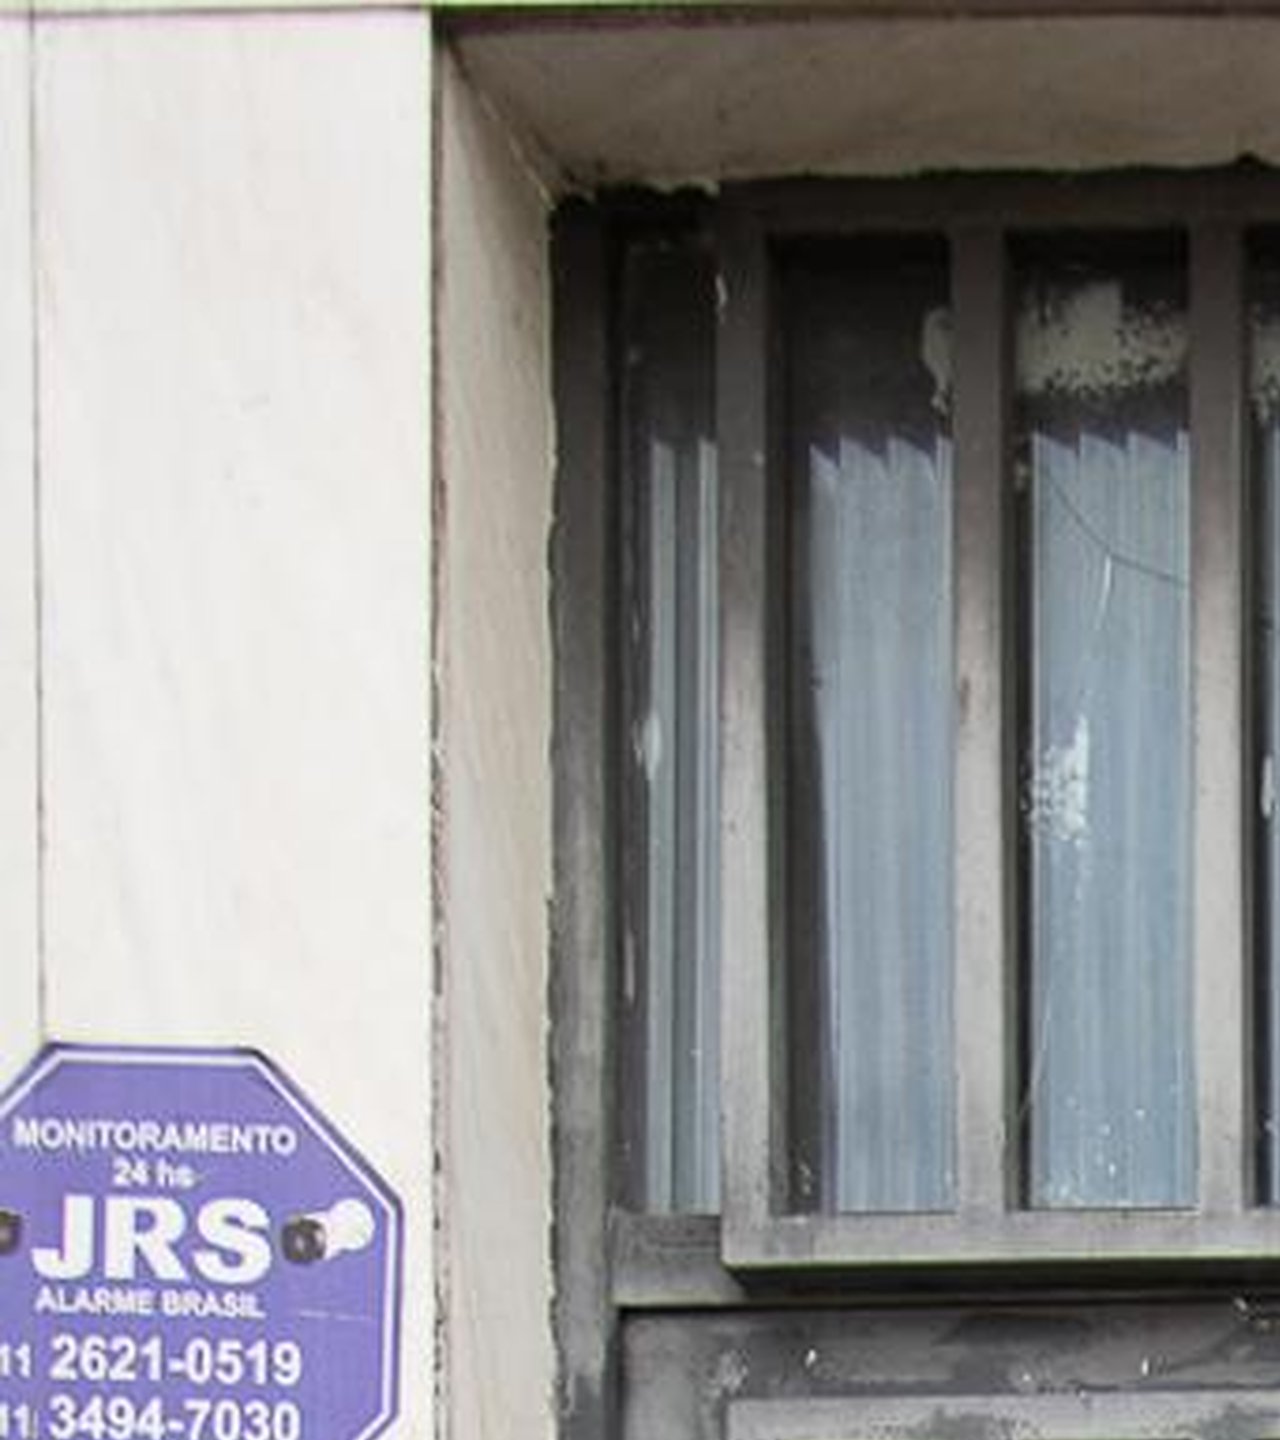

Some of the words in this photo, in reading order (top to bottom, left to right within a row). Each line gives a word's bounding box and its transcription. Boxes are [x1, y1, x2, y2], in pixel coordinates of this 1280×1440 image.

[13, 1117, 298, 1155] MONITORAMENTO
[112, 1157, 149, 1187] 24
[30, 1194, 272, 1285] JRS
[35, 1286, 153, 1315] ALARME
[161, 1289, 266, 1319] BRASIL
[50, 1334, 301, 1386] 2621-0519
